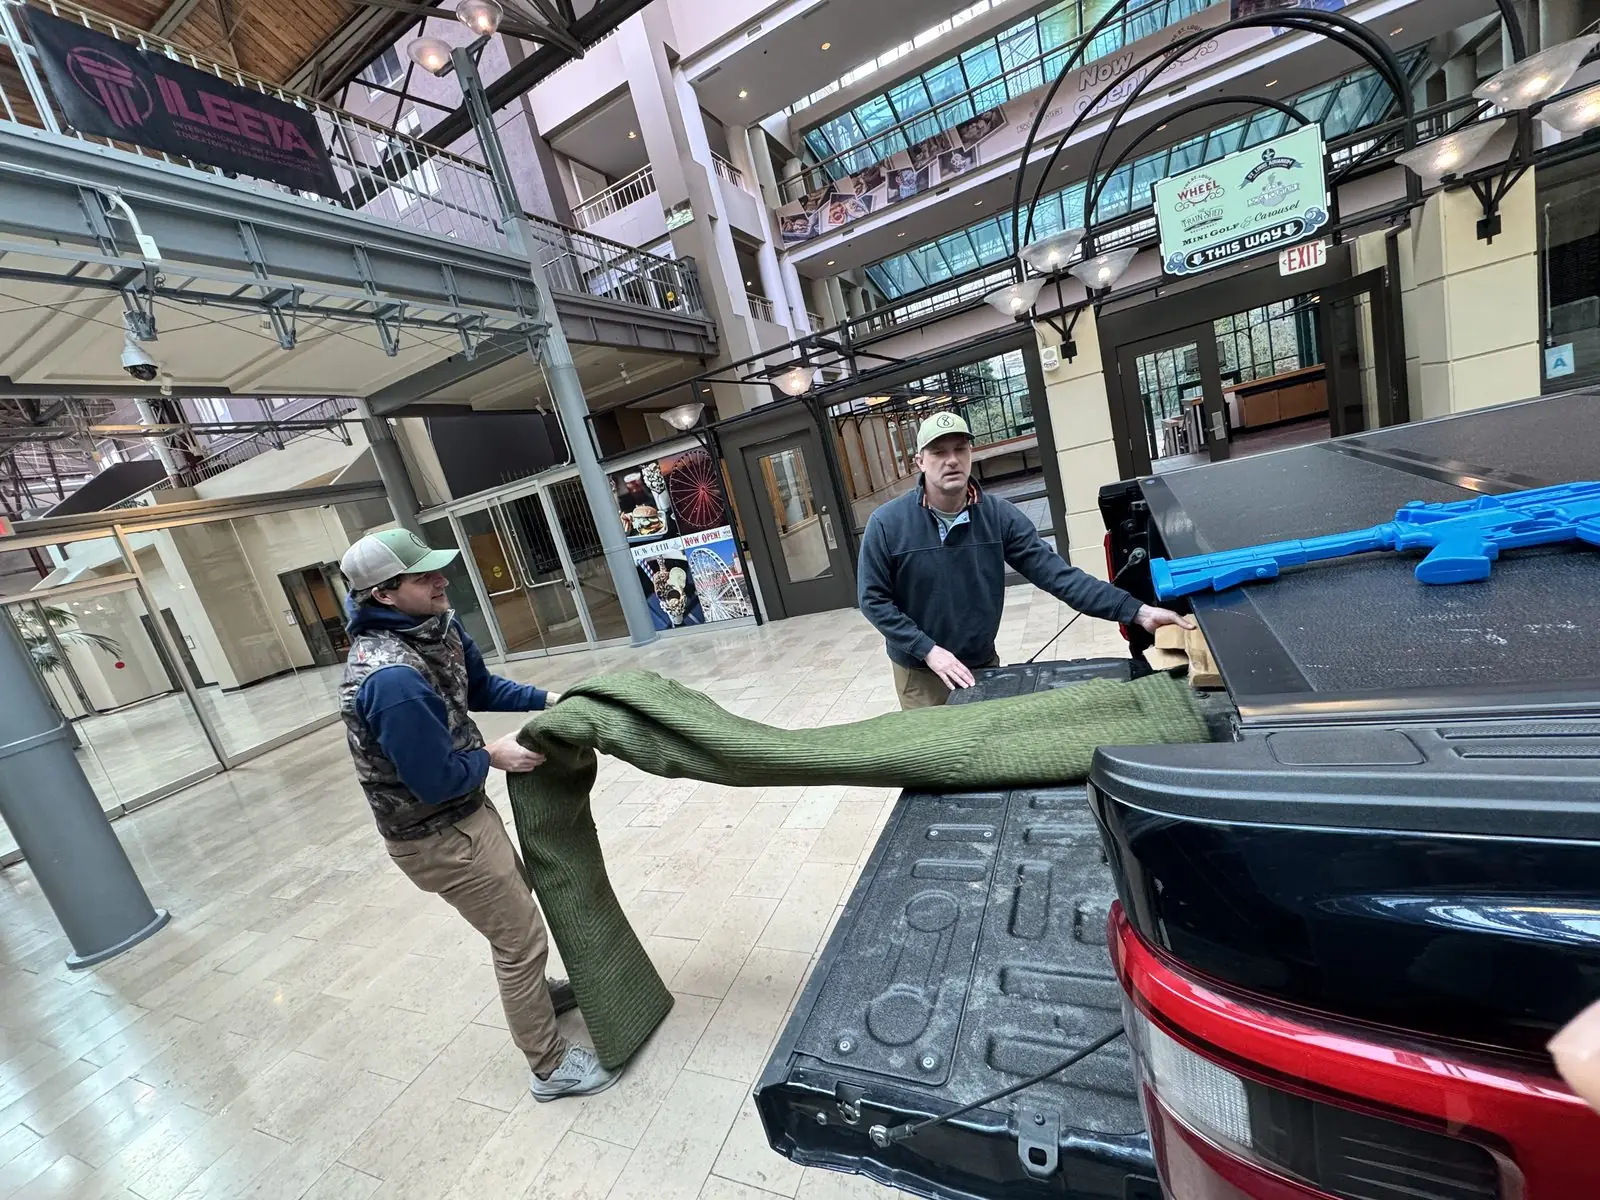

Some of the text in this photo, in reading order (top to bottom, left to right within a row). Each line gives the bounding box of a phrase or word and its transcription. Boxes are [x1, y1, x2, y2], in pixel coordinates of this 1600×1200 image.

[155, 73, 317, 158] ILEETA
[1177, 180, 1220, 200] WHEEL
[1182, 234, 1208, 246] MINI
[1212, 223, 1239, 236] GOLF
[1254, 200, 1300, 222] Carousel
[1206, 228, 1281, 261] THIS WAY
[1287, 243, 1319, 271] EXIT
